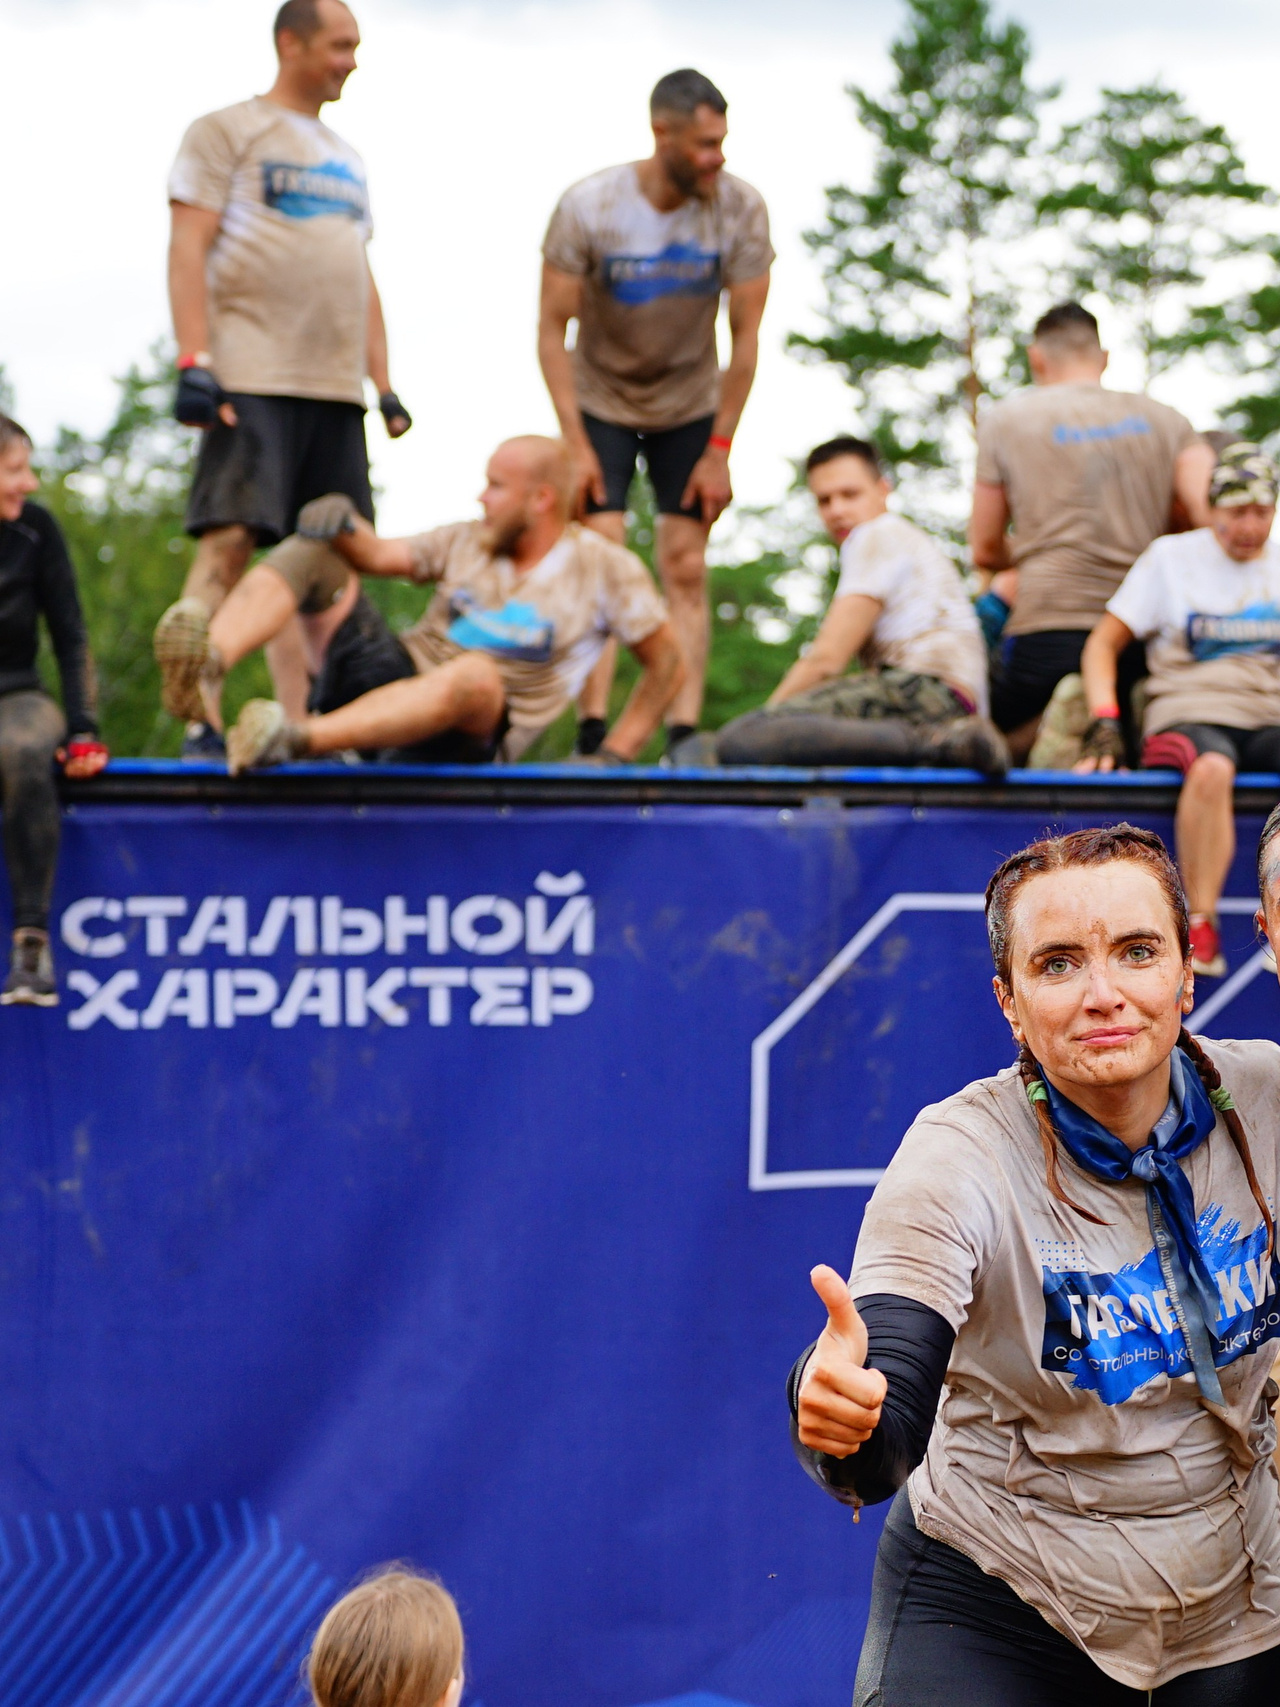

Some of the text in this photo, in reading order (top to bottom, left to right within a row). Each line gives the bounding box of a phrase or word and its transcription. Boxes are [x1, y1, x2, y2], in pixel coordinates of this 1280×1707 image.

[60, 870, 595, 958] СТАЛЬНОЙ
[67, 967, 594, 1030] ХАРАКТЕР
[1067, 1250, 1277, 1340] ГАЗОВКИ
[1054, 1346, 1083, 1362] со
